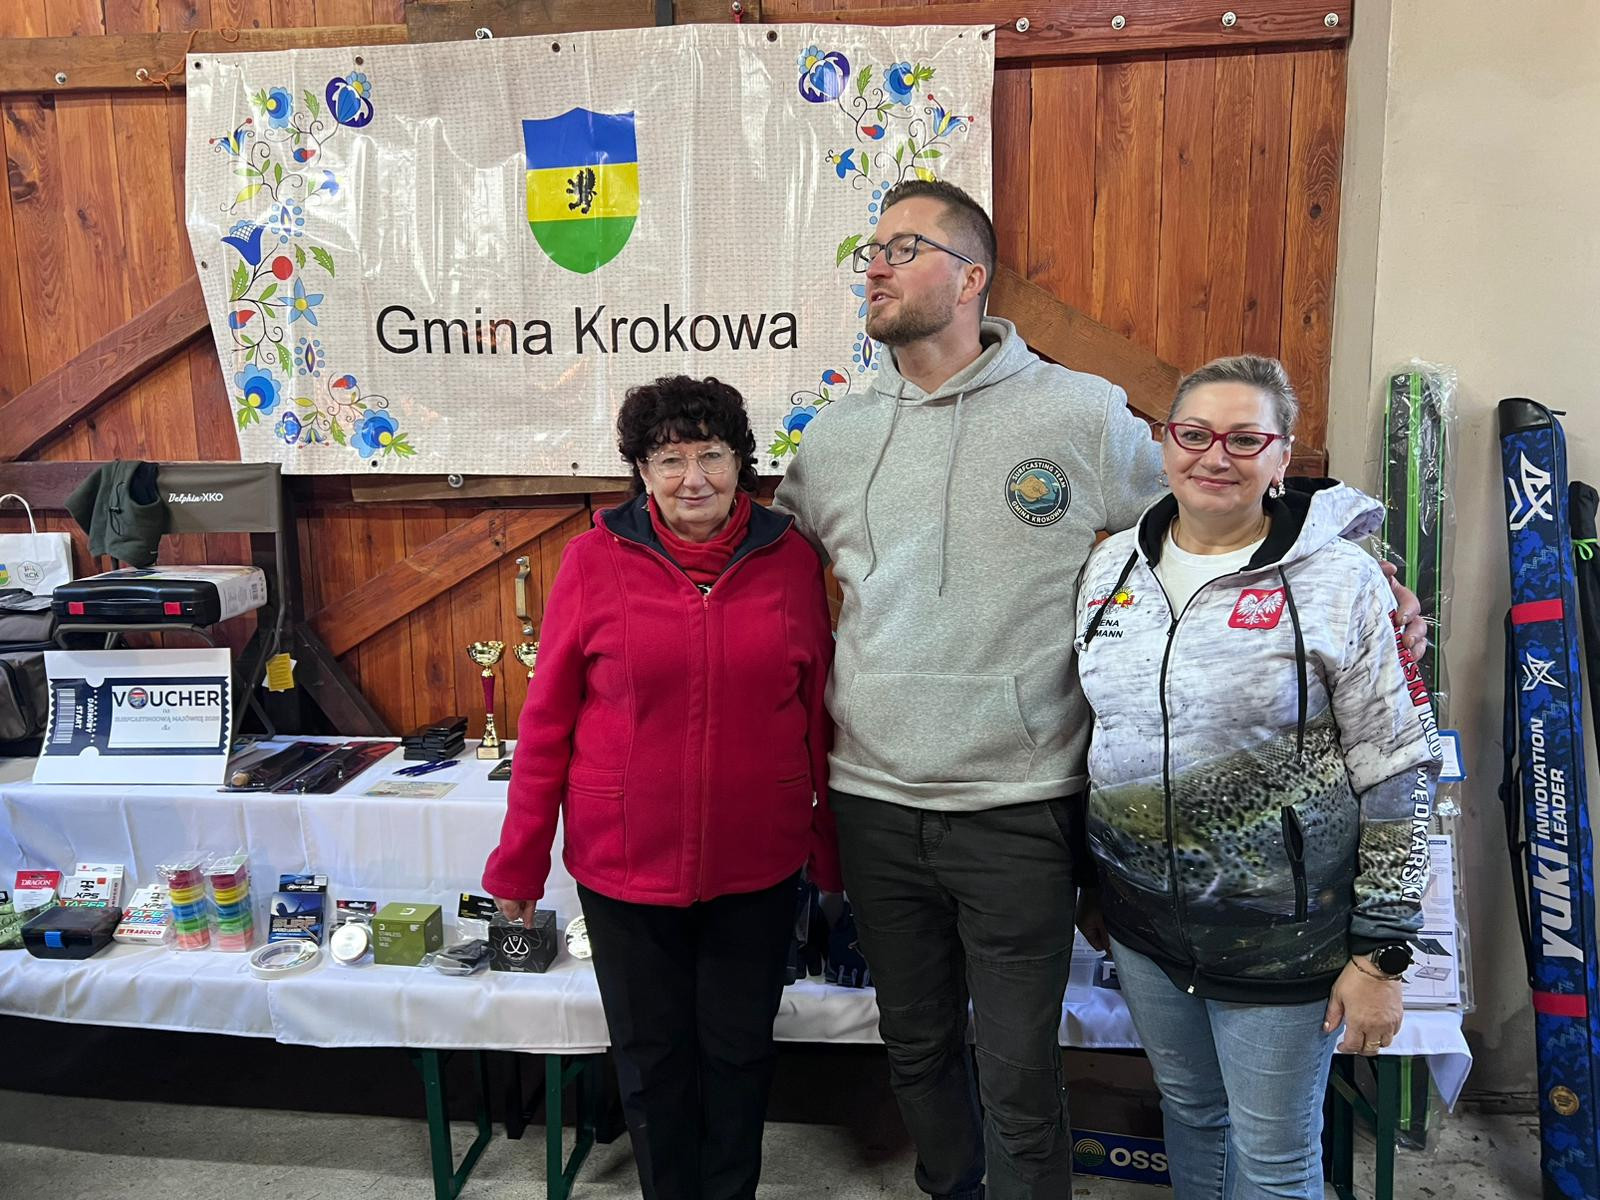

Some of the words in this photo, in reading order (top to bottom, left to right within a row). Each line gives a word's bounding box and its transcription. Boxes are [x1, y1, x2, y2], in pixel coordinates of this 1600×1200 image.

[376, 304, 553, 355] Gmina
[574, 303, 798, 354] Krokowa
[1012, 462, 1054, 481] SURFCASTING
[1053, 470, 1067, 489] TEAM
[1011, 500, 1030, 520] GMINA
[1031, 508, 1063, 524] KROKOWA
[74, 705, 83, 730] START
[111, 687, 221, 709] VOUCHER
[1530, 718, 1550, 840] INNOVATION
[1550, 768, 1569, 846] LEADER
[1401, 765, 1431, 904] WĘDKARSKI
